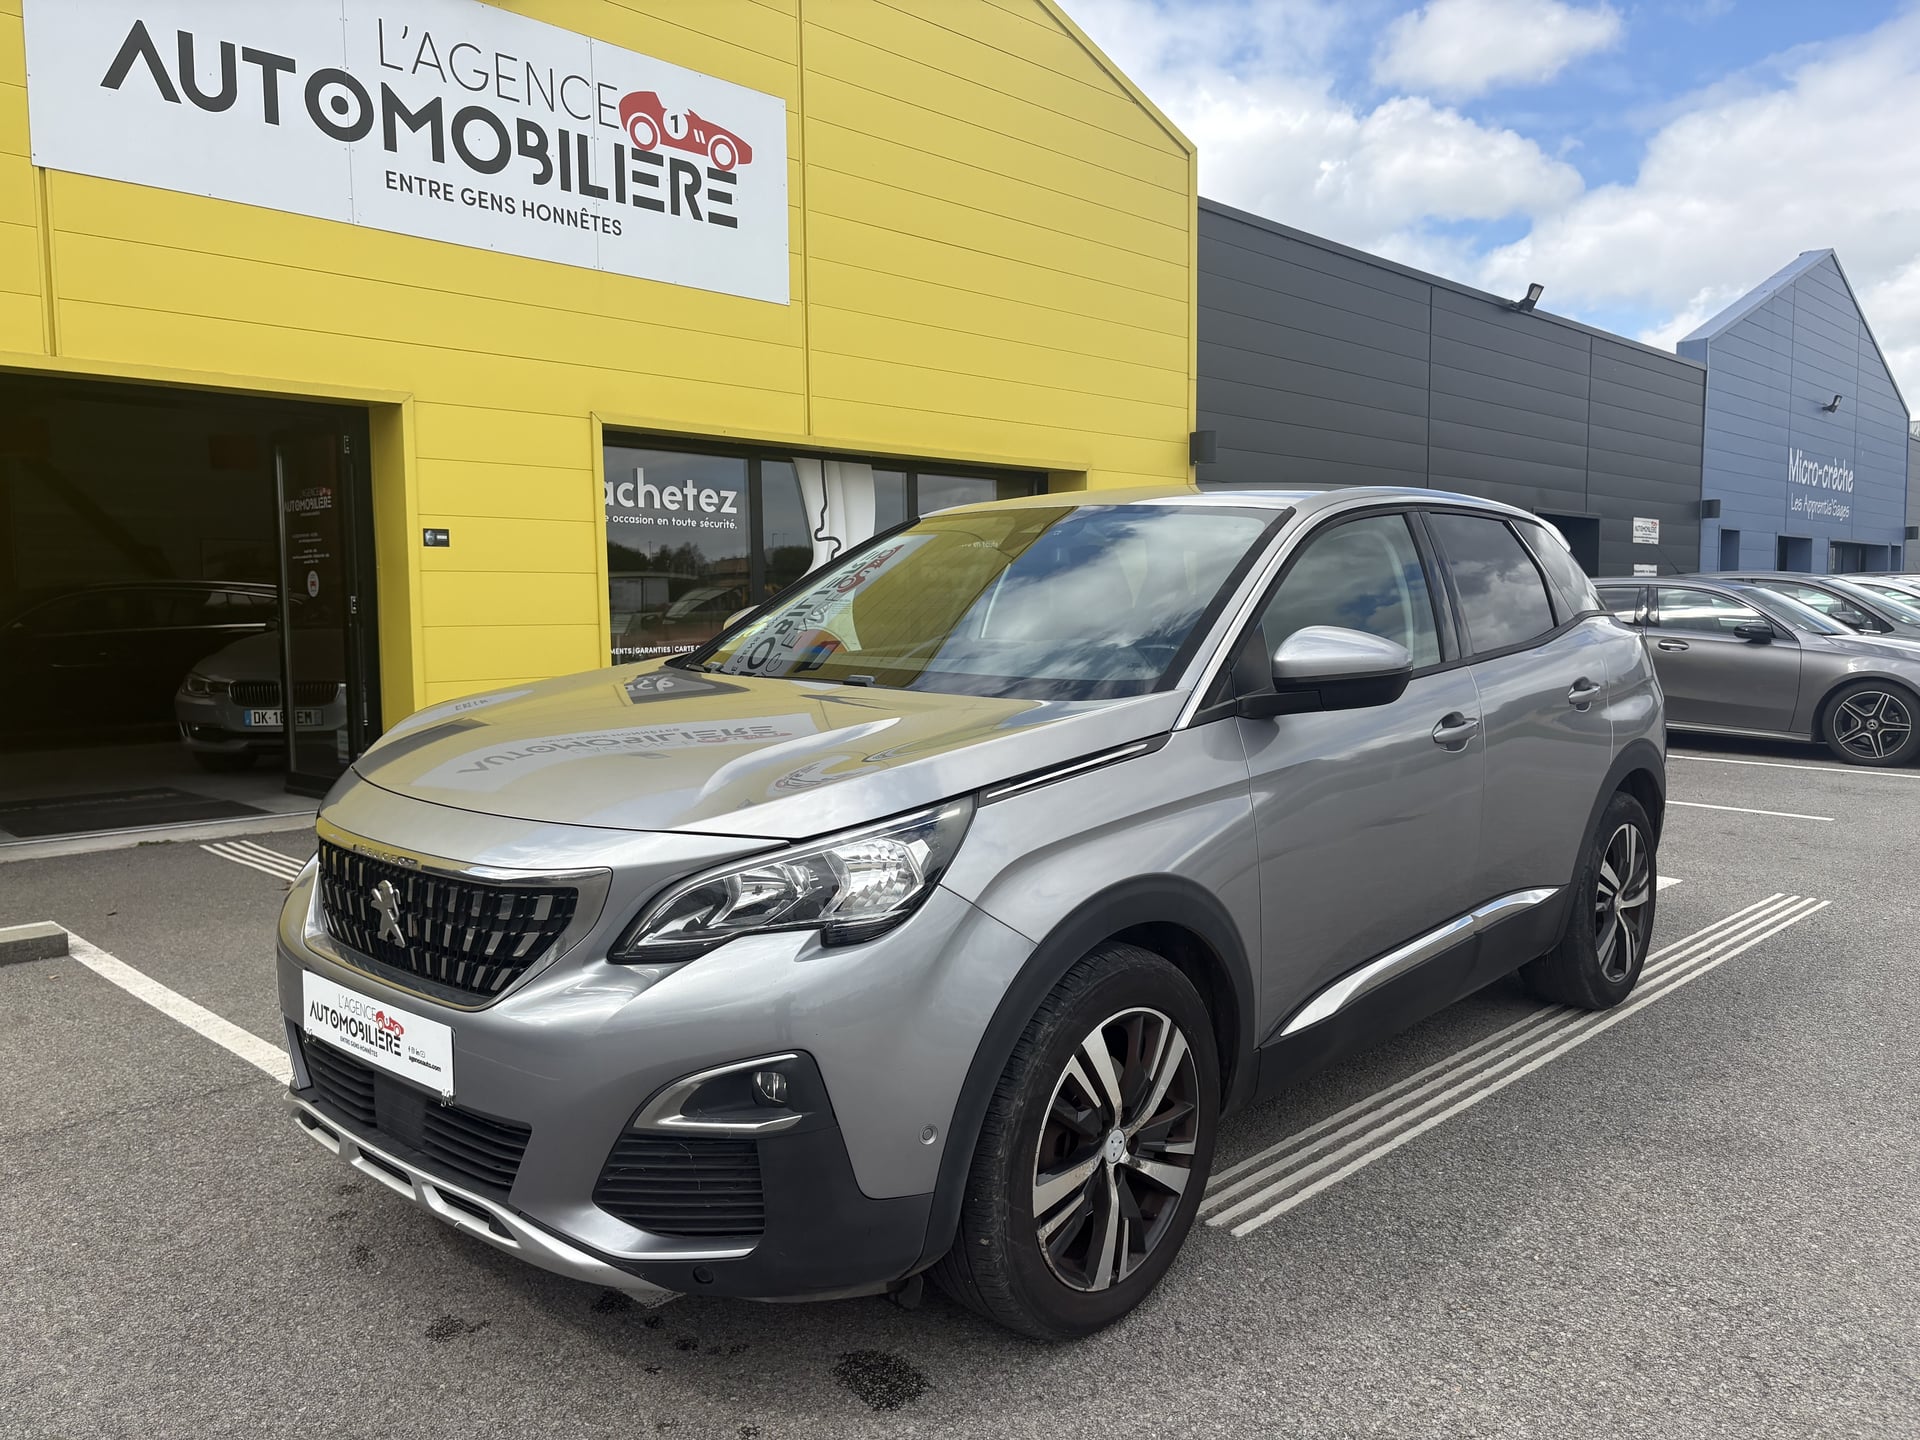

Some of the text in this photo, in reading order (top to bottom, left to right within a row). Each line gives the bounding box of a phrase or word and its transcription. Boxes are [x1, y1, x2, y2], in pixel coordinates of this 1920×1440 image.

[378, 17, 619, 129] L'AGENCE
[385, 170, 622, 236] ENTRE GENS HONNÊTES
[1788, 447, 1854, 493] Micro-crèche
[612, 513, 655, 525] occasion
[657, 518, 669, 526] en
[671, 517, 697, 528] toute
[699, 517, 738, 530] sécurité.
[635, 646, 671, 655] GARANTIES
[674, 644, 695, 654] CARTE
[338, 993, 376, 1023] L'AGENCE
